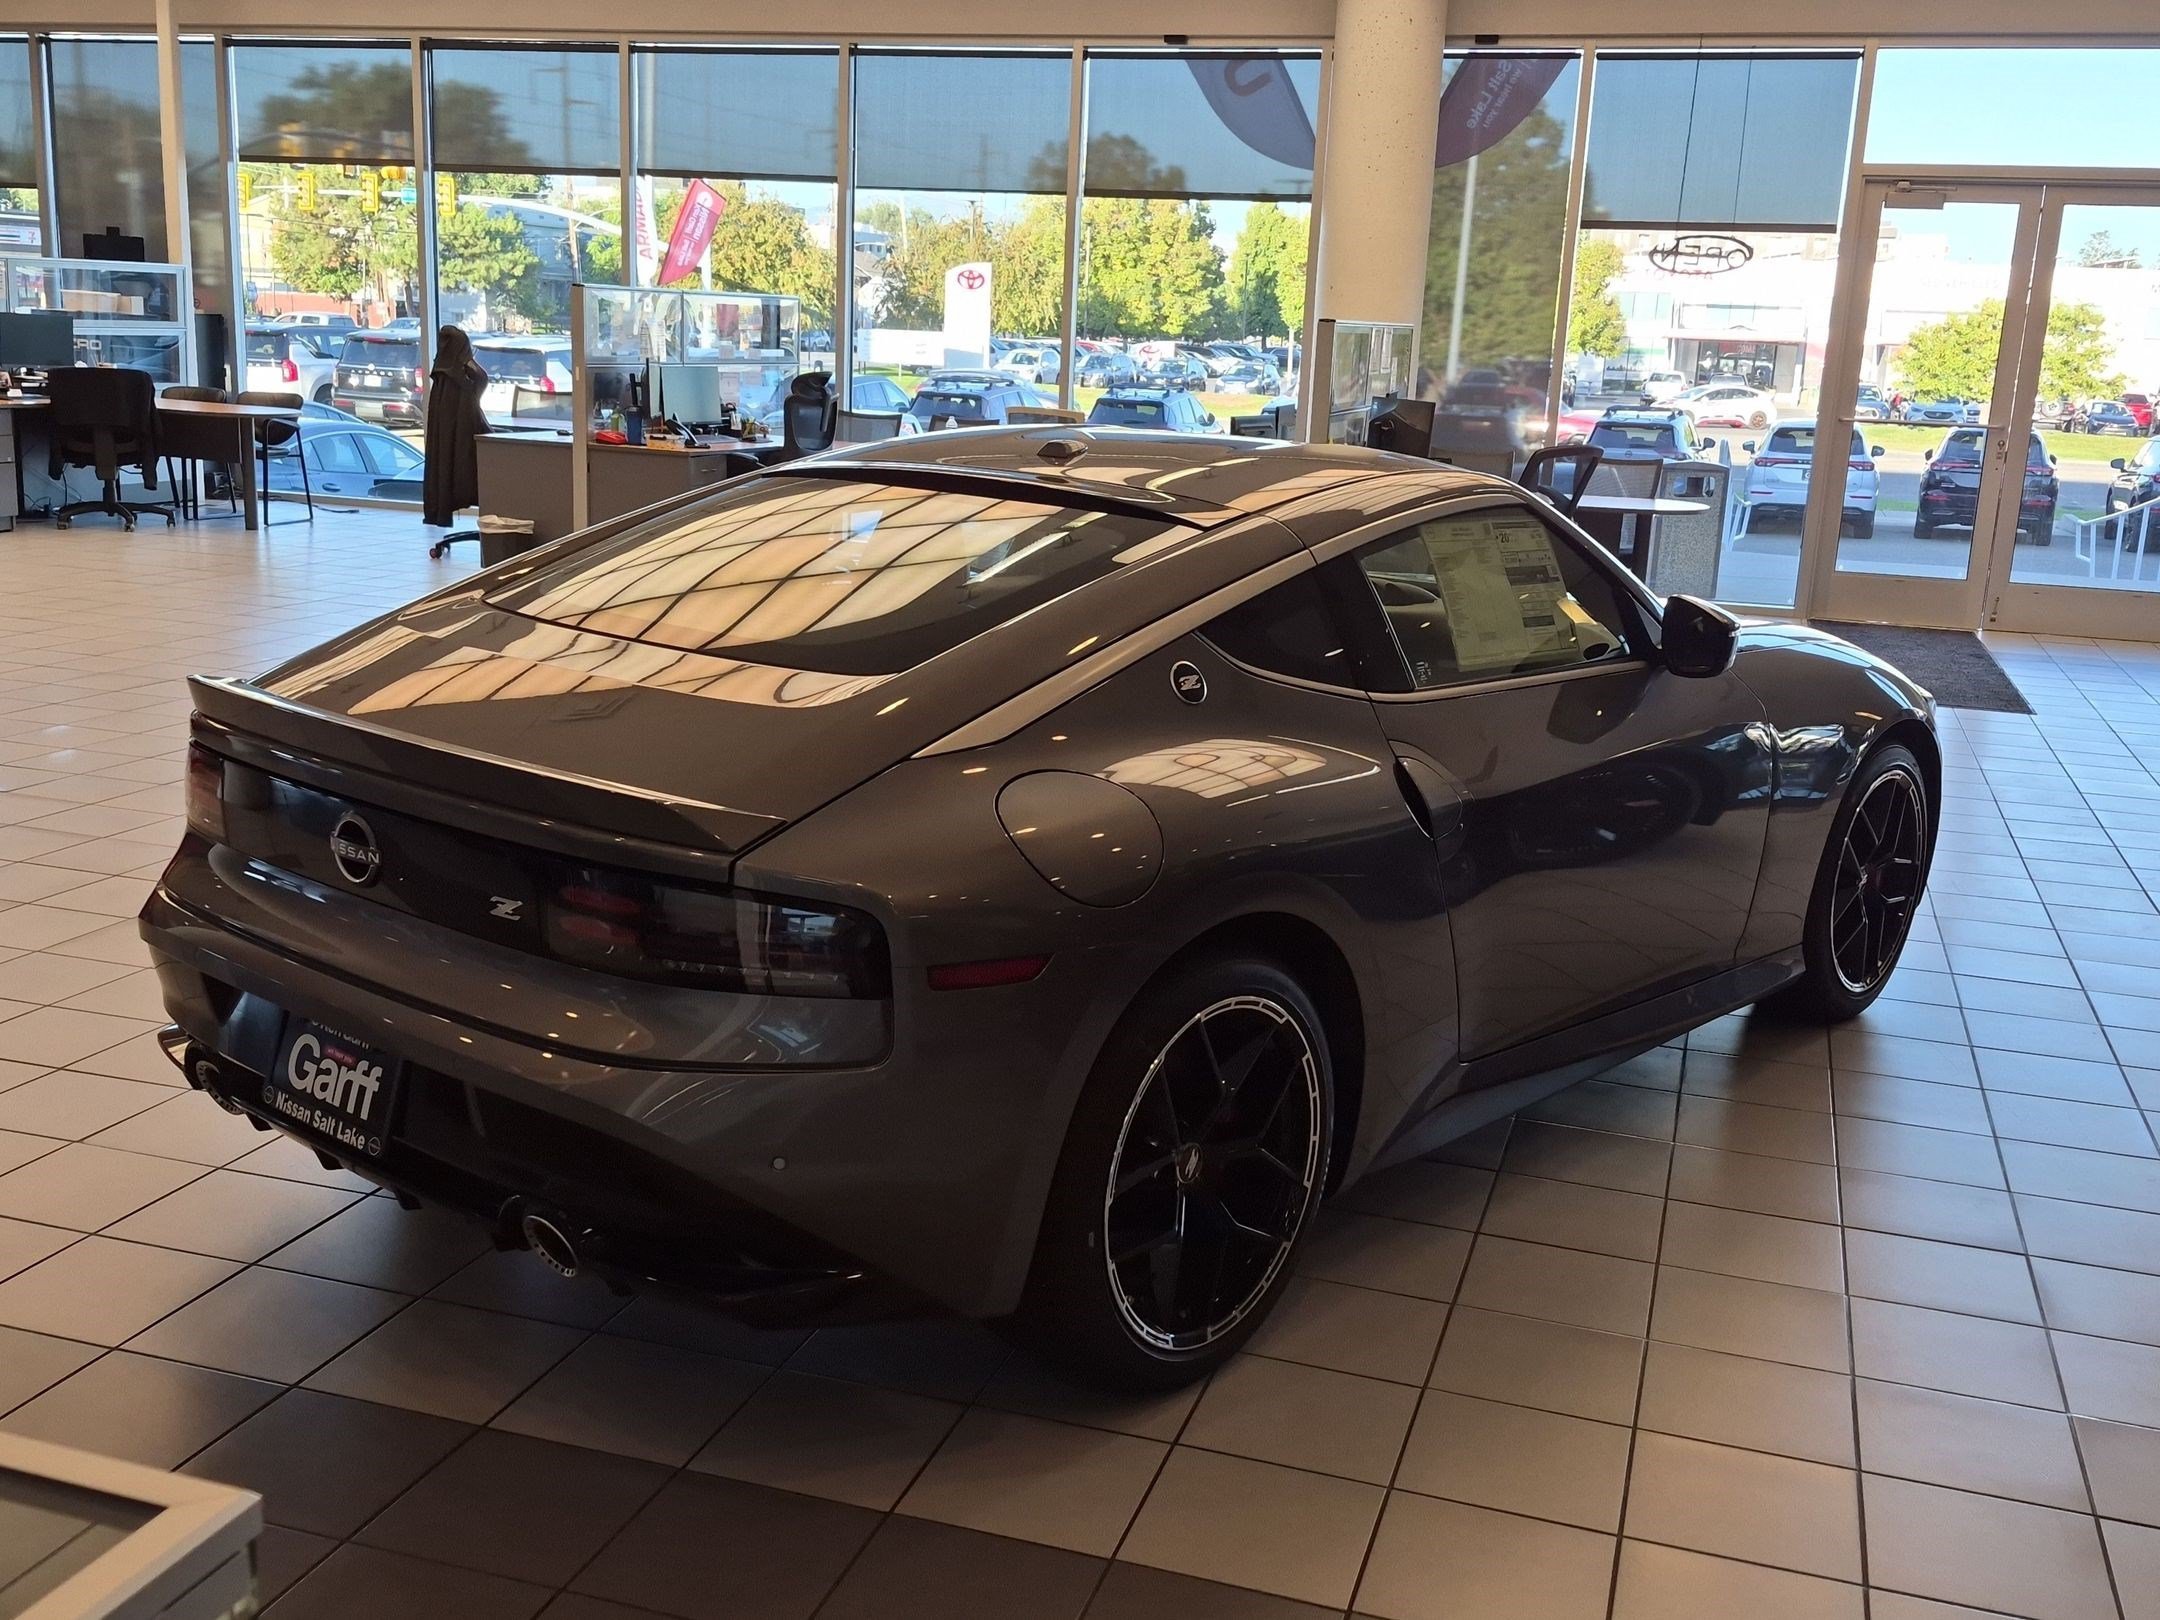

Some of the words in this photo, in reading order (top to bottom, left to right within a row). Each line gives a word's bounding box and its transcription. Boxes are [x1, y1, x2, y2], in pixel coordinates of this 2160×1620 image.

[490, 896, 523, 921] Z
[287, 1033, 383, 1121] Garff
[275, 1091, 311, 1124] Nissan
[312, 1110, 336, 1136] Salt
[337, 1121, 366, 1150] Lake
